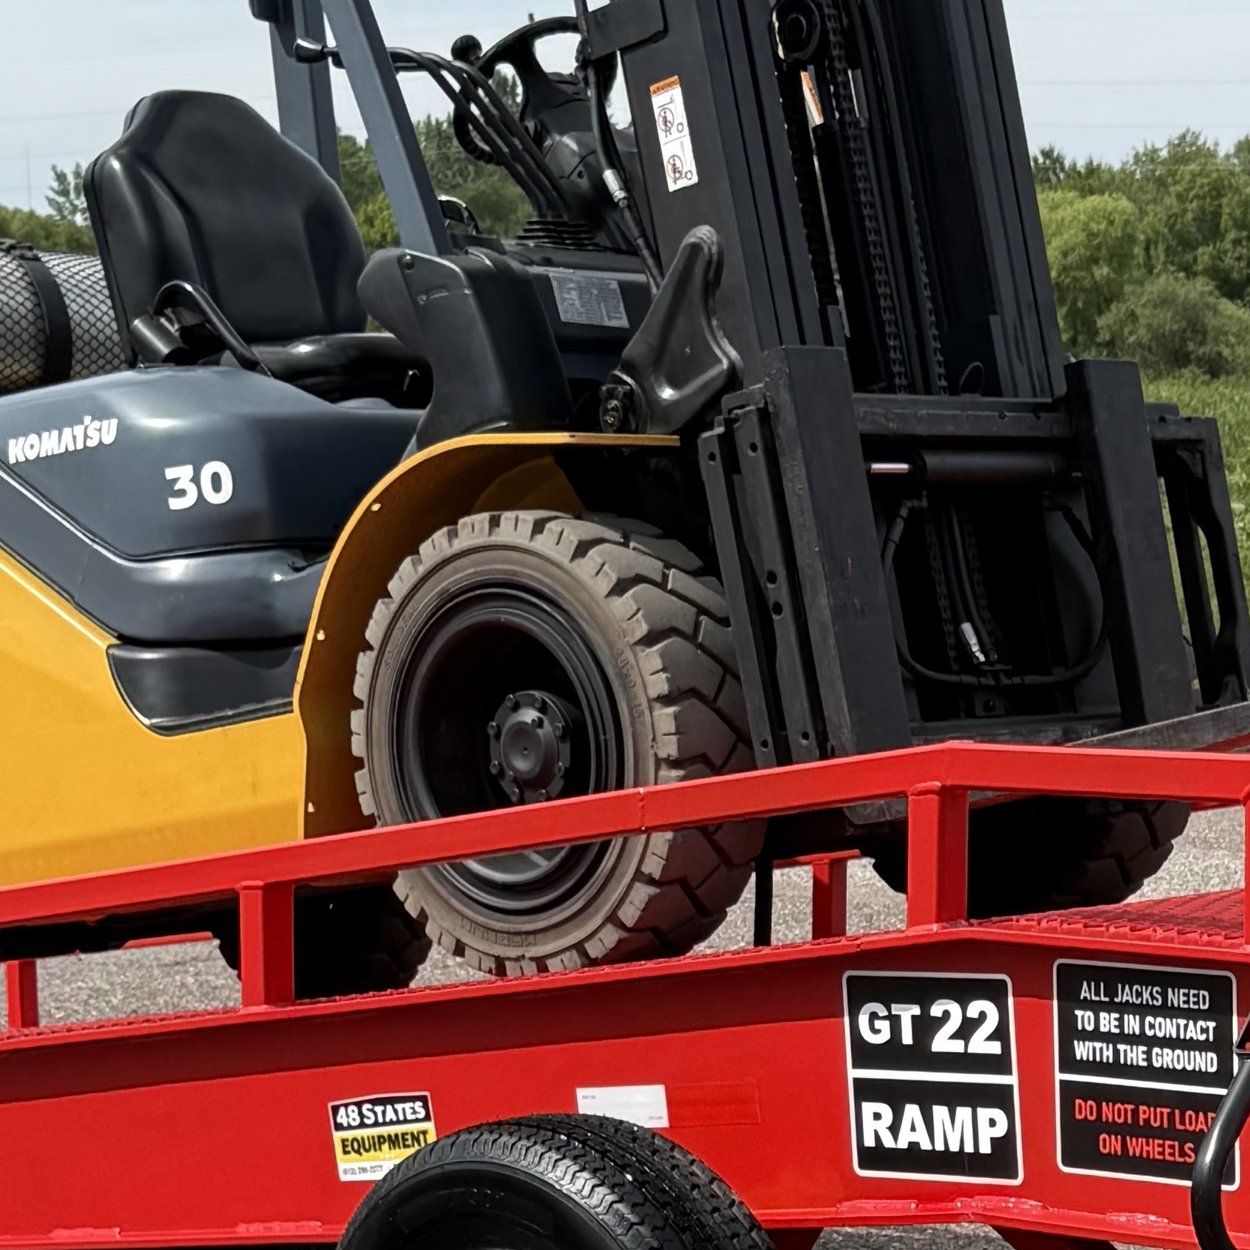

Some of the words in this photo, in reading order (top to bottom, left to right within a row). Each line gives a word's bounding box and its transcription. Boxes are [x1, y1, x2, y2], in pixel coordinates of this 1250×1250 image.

[8, 415, 118, 464] KOMATSU
[164, 461, 233, 510] 30
[1080, 980, 1110, 1002] ALL
[1114, 983, 1163, 1006] JACKS
[1167, 988, 1210, 1010] NEED
[858, 1002, 921, 1045] GT
[929, 999, 1002, 1055] 22
[1074, 1010, 1095, 1031] TO
[1100, 1012, 1121, 1034] BE
[1124, 1014, 1140, 1035] IN
[1144, 1016, 1216, 1042] CONTACT
[1074, 1040, 1114, 1063] WITH
[1117, 1044, 1148, 1066] THE
[1151, 1048, 1218, 1073] GROUND
[336, 1104, 361, 1127] 48
[362, 1101, 426, 1125] STATES
[861, 1101, 1009, 1154] RAMP
[1074, 1098, 1097, 1121] DO
[1102, 1101, 1136, 1124] NOT
[1139, 1105, 1171, 1129] PUT
[340, 1130, 428, 1156] EQUIPMENT
[1099, 1133, 1122, 1155] ON
[1127, 1135, 1196, 1163] WHEELS
